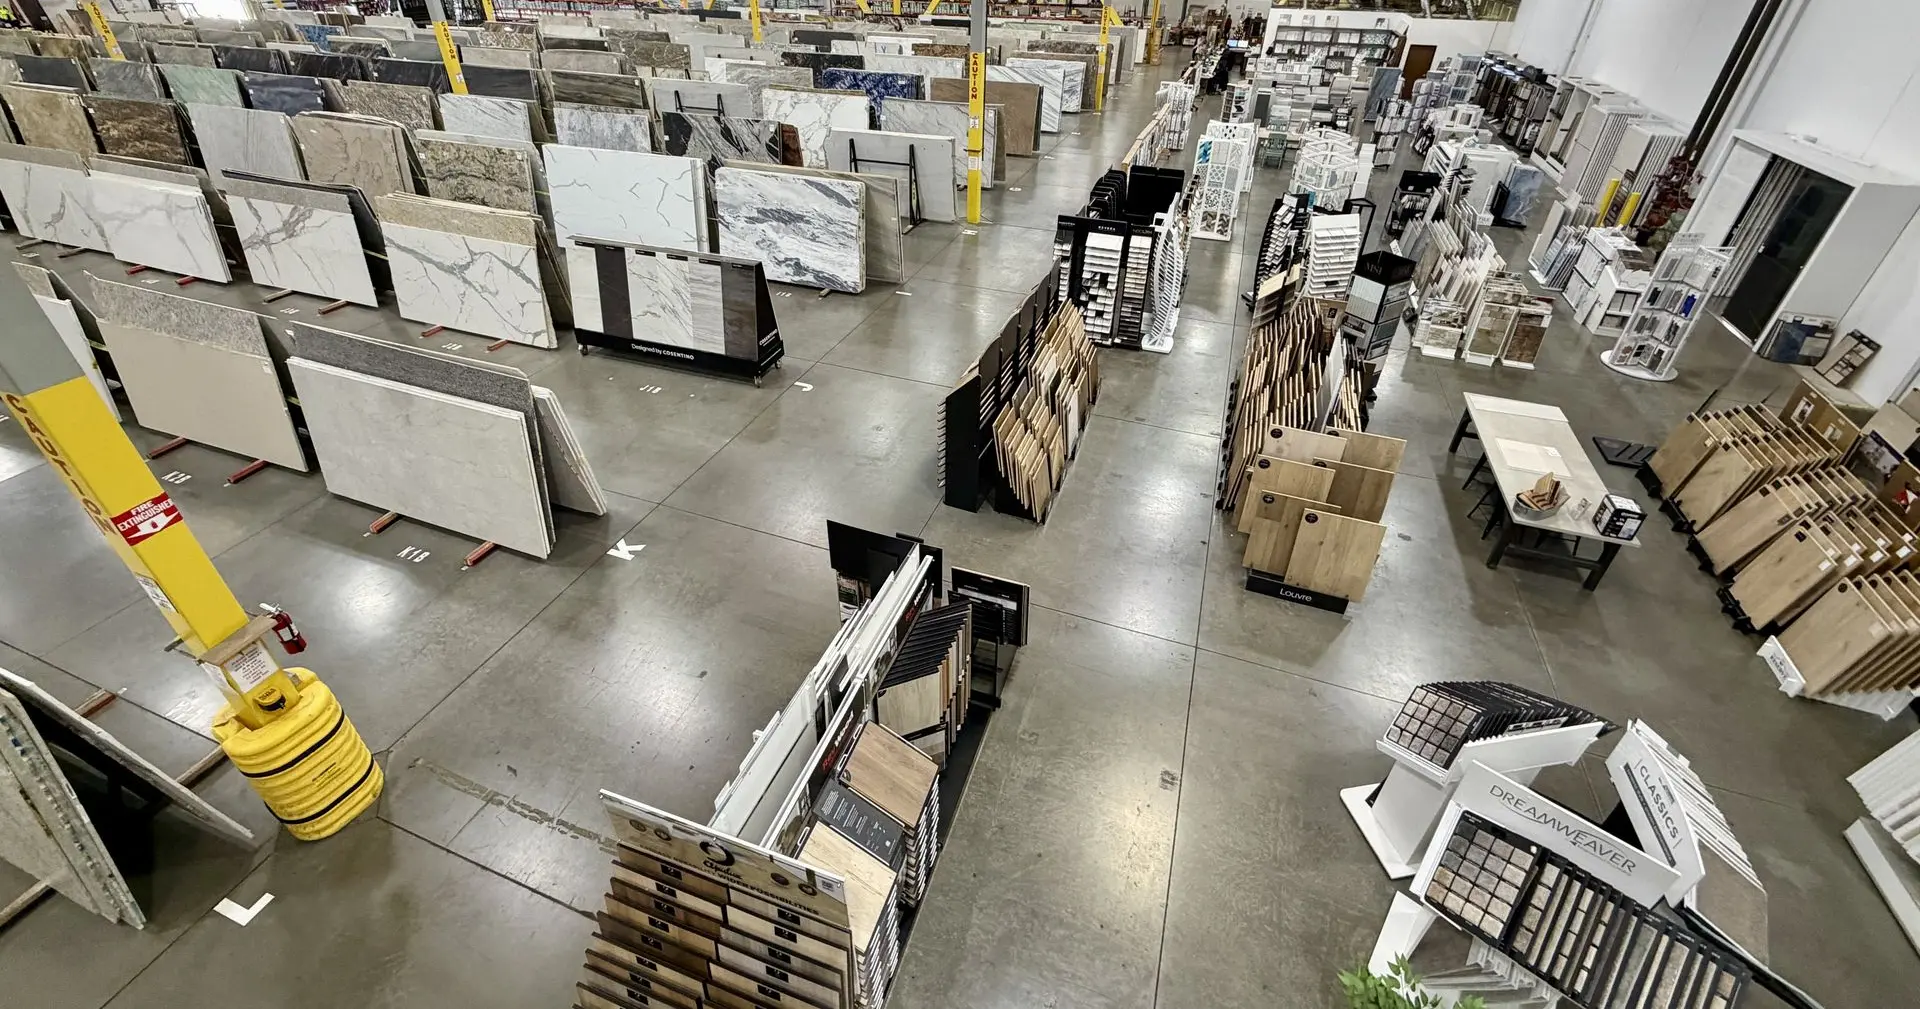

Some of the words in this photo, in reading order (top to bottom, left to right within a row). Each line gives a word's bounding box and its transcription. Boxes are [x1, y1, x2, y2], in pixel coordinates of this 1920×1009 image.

[441, 21, 456, 59] CAUTION
[631, 343, 655, 353] Designed
[662, 349, 695, 361] COSENTINO
[793, 381, 814, 392] J
[6, 393, 118, 536] CAUTION
[130, 500, 155, 516] FIRE
[396, 545, 431, 563] K1B
[606, 538, 647, 561] K
[1279, 587, 1313, 602] Louvre
[1639, 764, 1679, 839] CLASSICS
[1489, 784, 1637, 874] DREAMWEAVER
[212, 892, 276, 927] L
[749, 883, 820, 916] POSSIBILITIES
